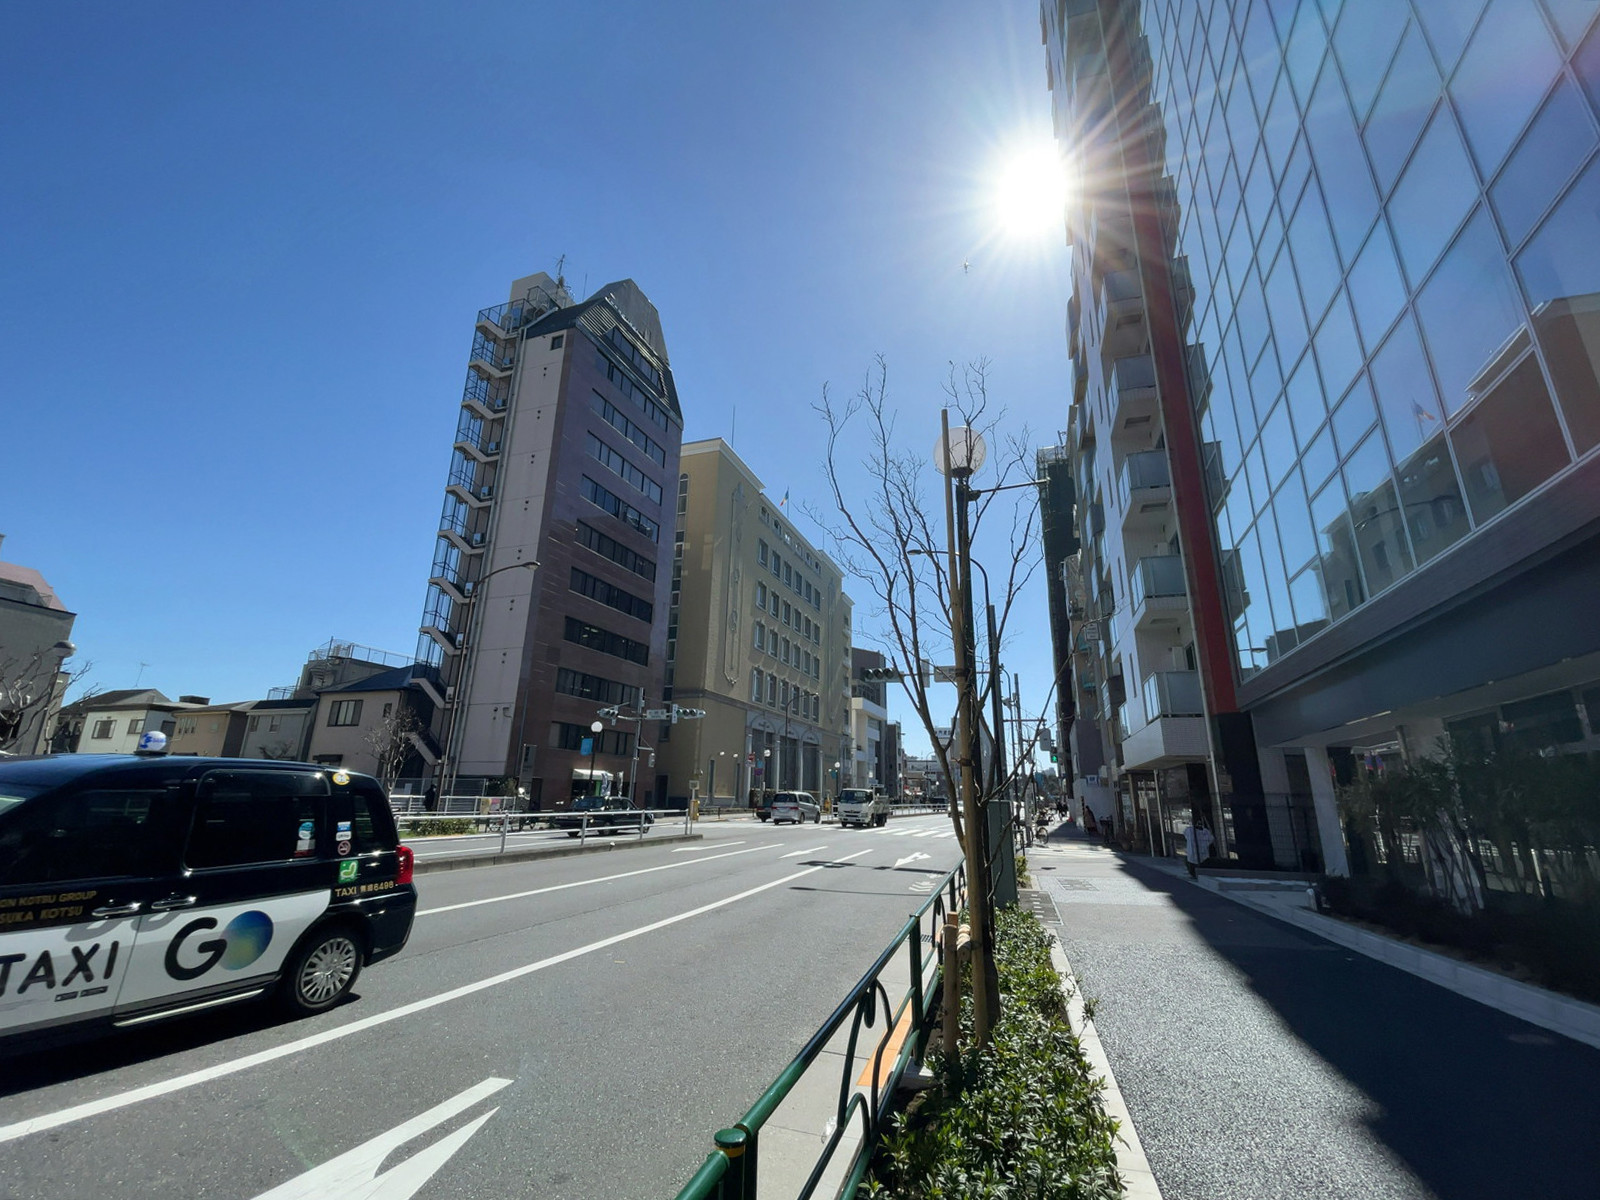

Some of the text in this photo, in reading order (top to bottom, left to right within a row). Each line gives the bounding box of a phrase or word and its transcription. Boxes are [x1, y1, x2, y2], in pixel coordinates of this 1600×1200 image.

[59, 891, 97, 902] GROUP
[335, 887, 357, 897] TAXI
[40, 906, 83, 919] KOTSU
[0, 940, 119, 997] TAXI
